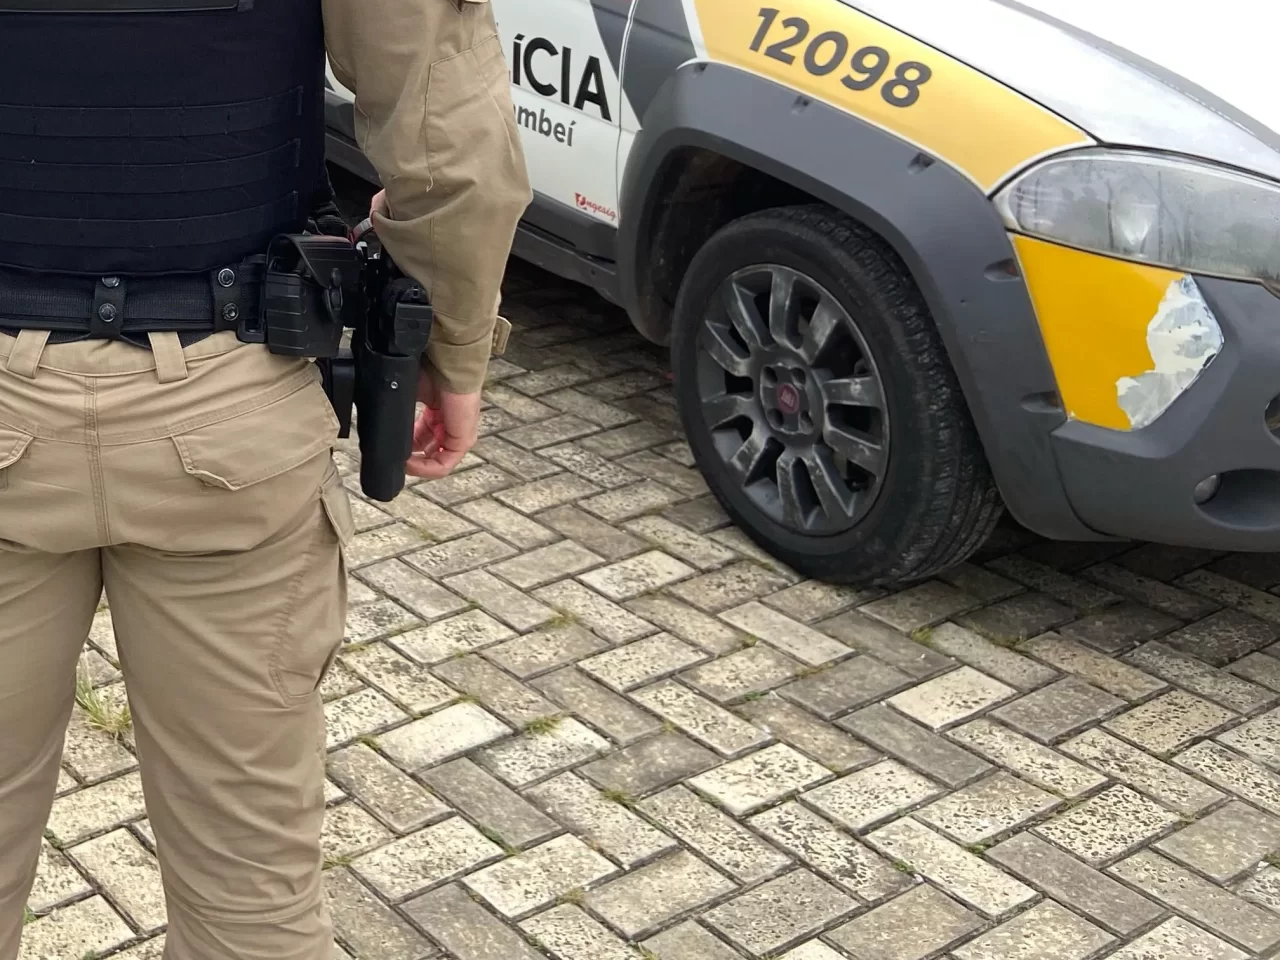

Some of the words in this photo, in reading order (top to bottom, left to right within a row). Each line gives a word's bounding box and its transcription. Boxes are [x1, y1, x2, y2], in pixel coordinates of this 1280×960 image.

[511, 33, 612, 123] ÍCIA
[749, 7, 933, 108] 12098
[513, 104, 577, 147] mbeí
